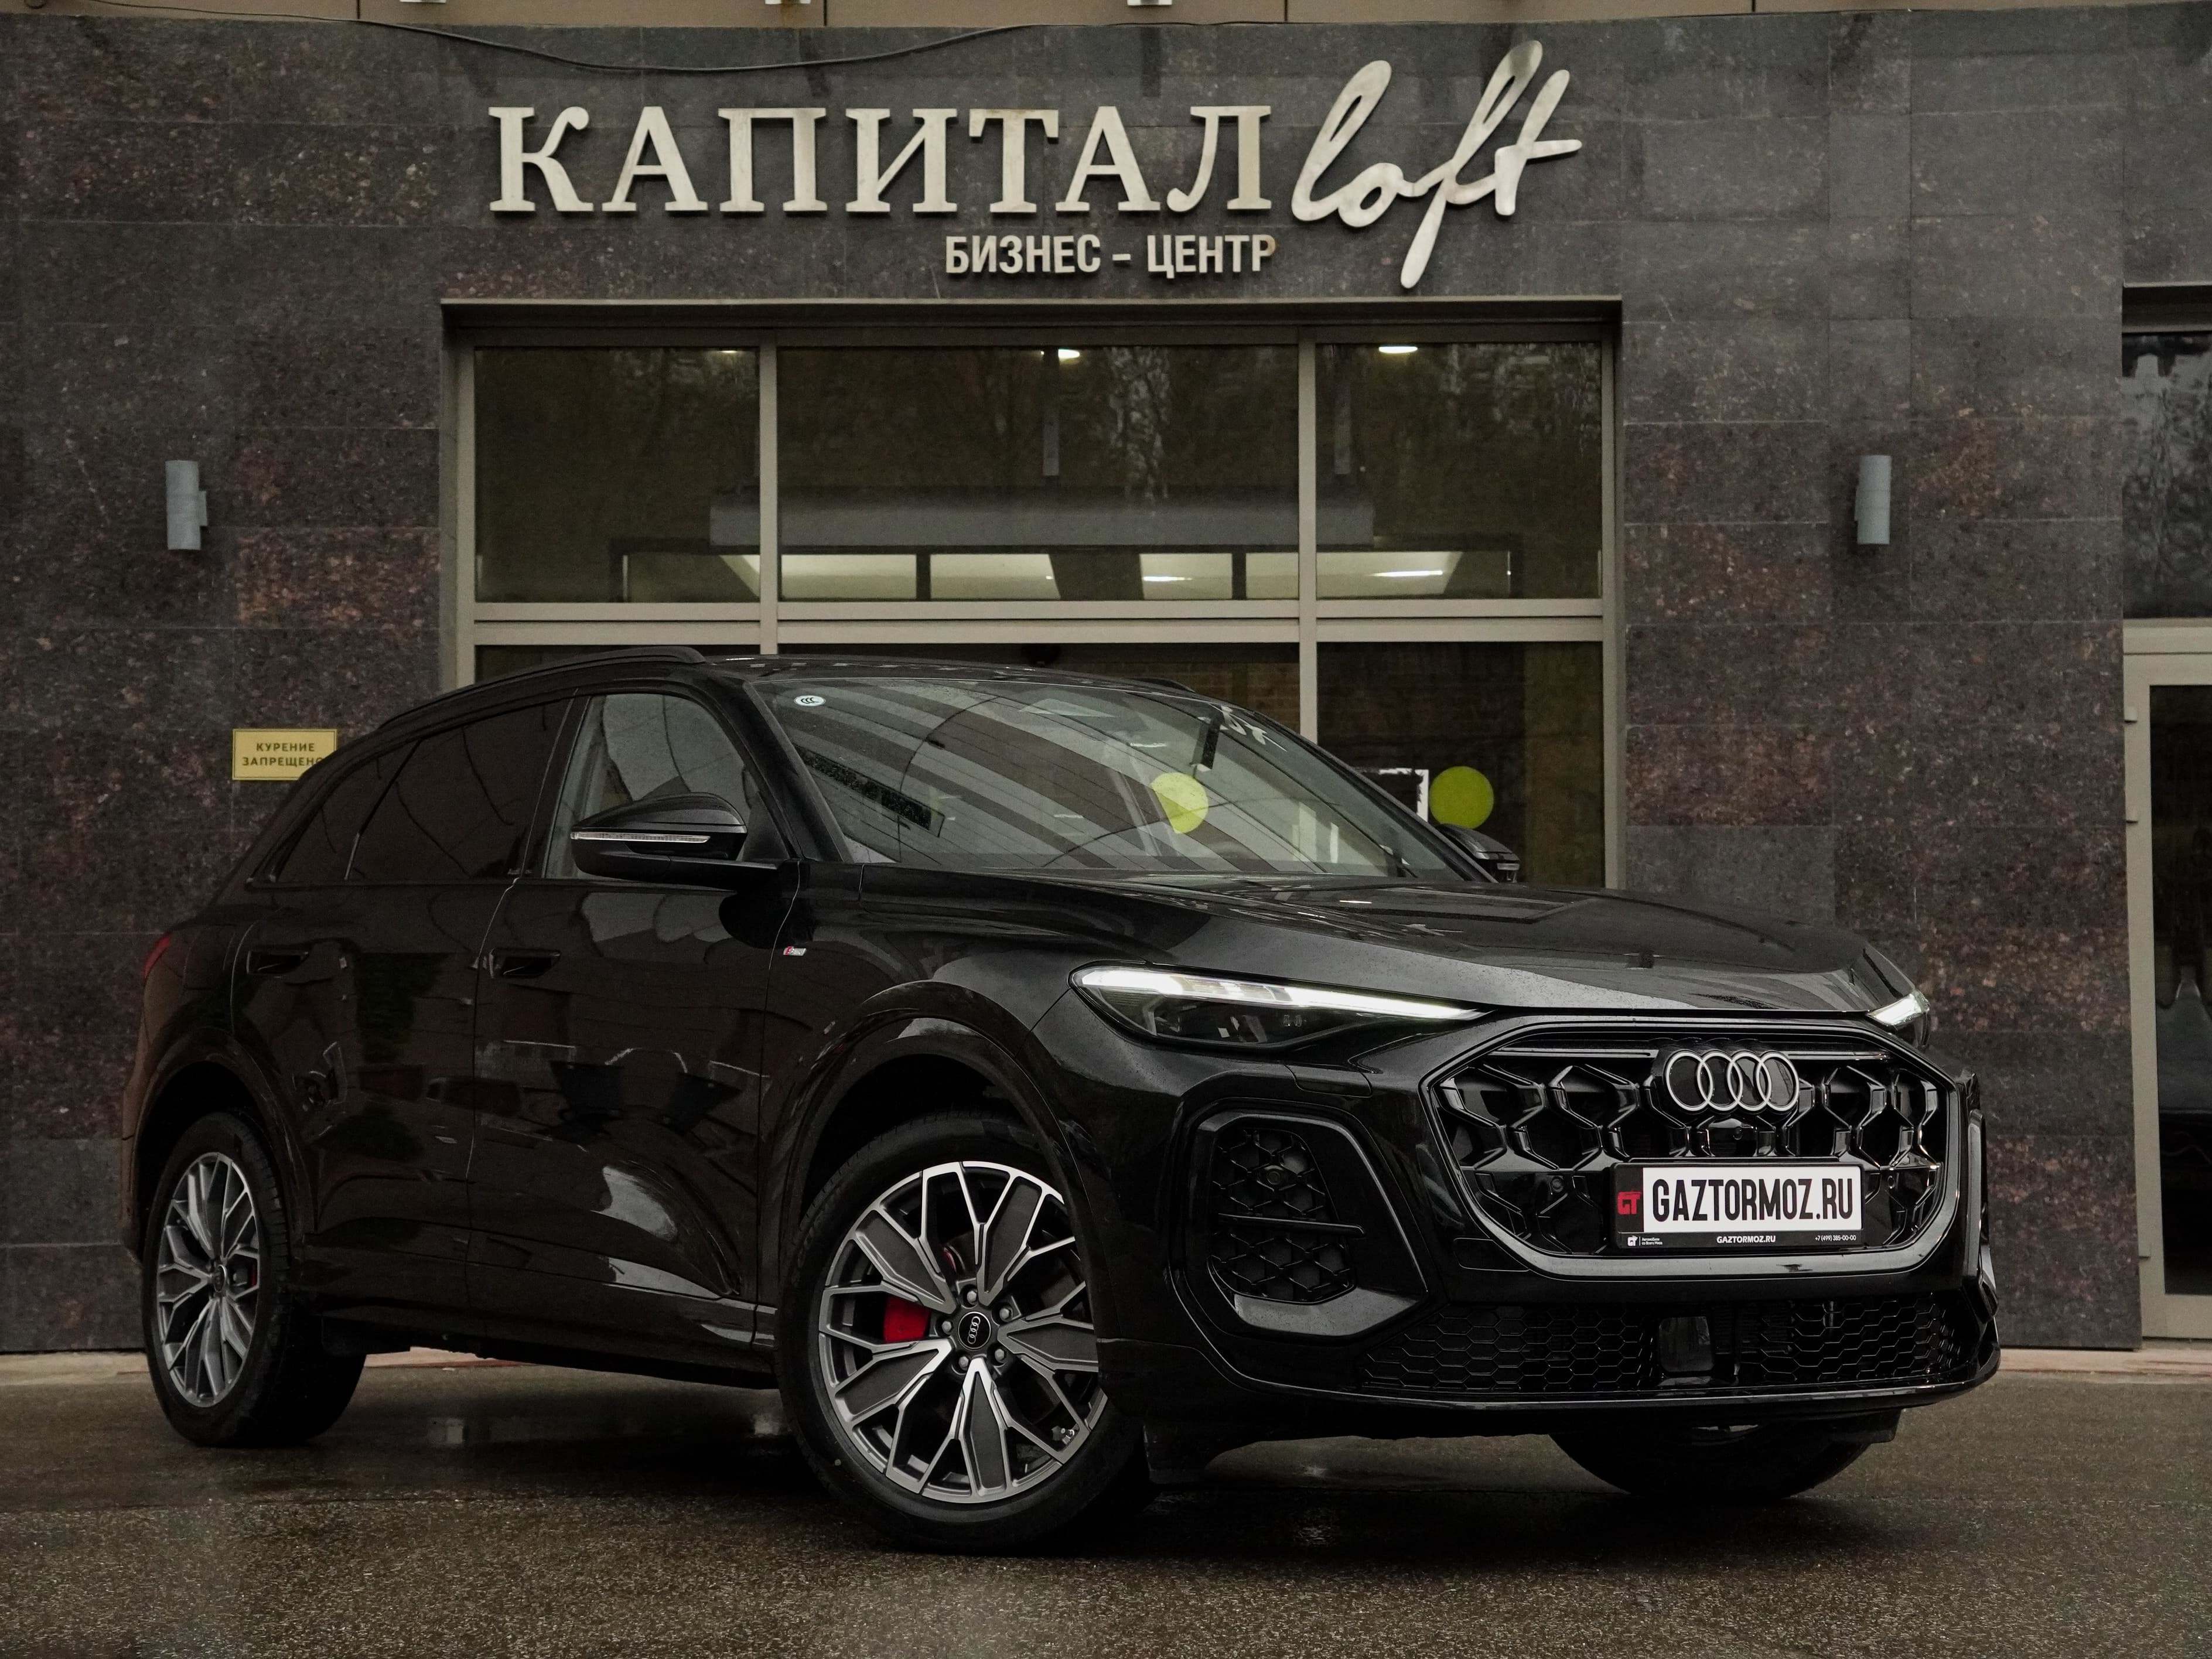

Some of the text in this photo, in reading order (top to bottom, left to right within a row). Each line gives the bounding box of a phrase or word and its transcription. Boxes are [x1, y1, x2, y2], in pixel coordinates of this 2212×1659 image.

[488, 105, 1272, 212] КАПИТАЛ
[1291, 40, 1582, 289] loft
[945, 234, 1101, 274] БИЗНЕС
[1147, 234, 1277, 279] ЦЕНТР
[256, 742, 315, 752] КУРЕНИЕ
[1651, 1178, 1853, 1222] GAZTORMOZ.RU
[1716, 1235, 1776, 1244] GAZTORMOZ.RU
